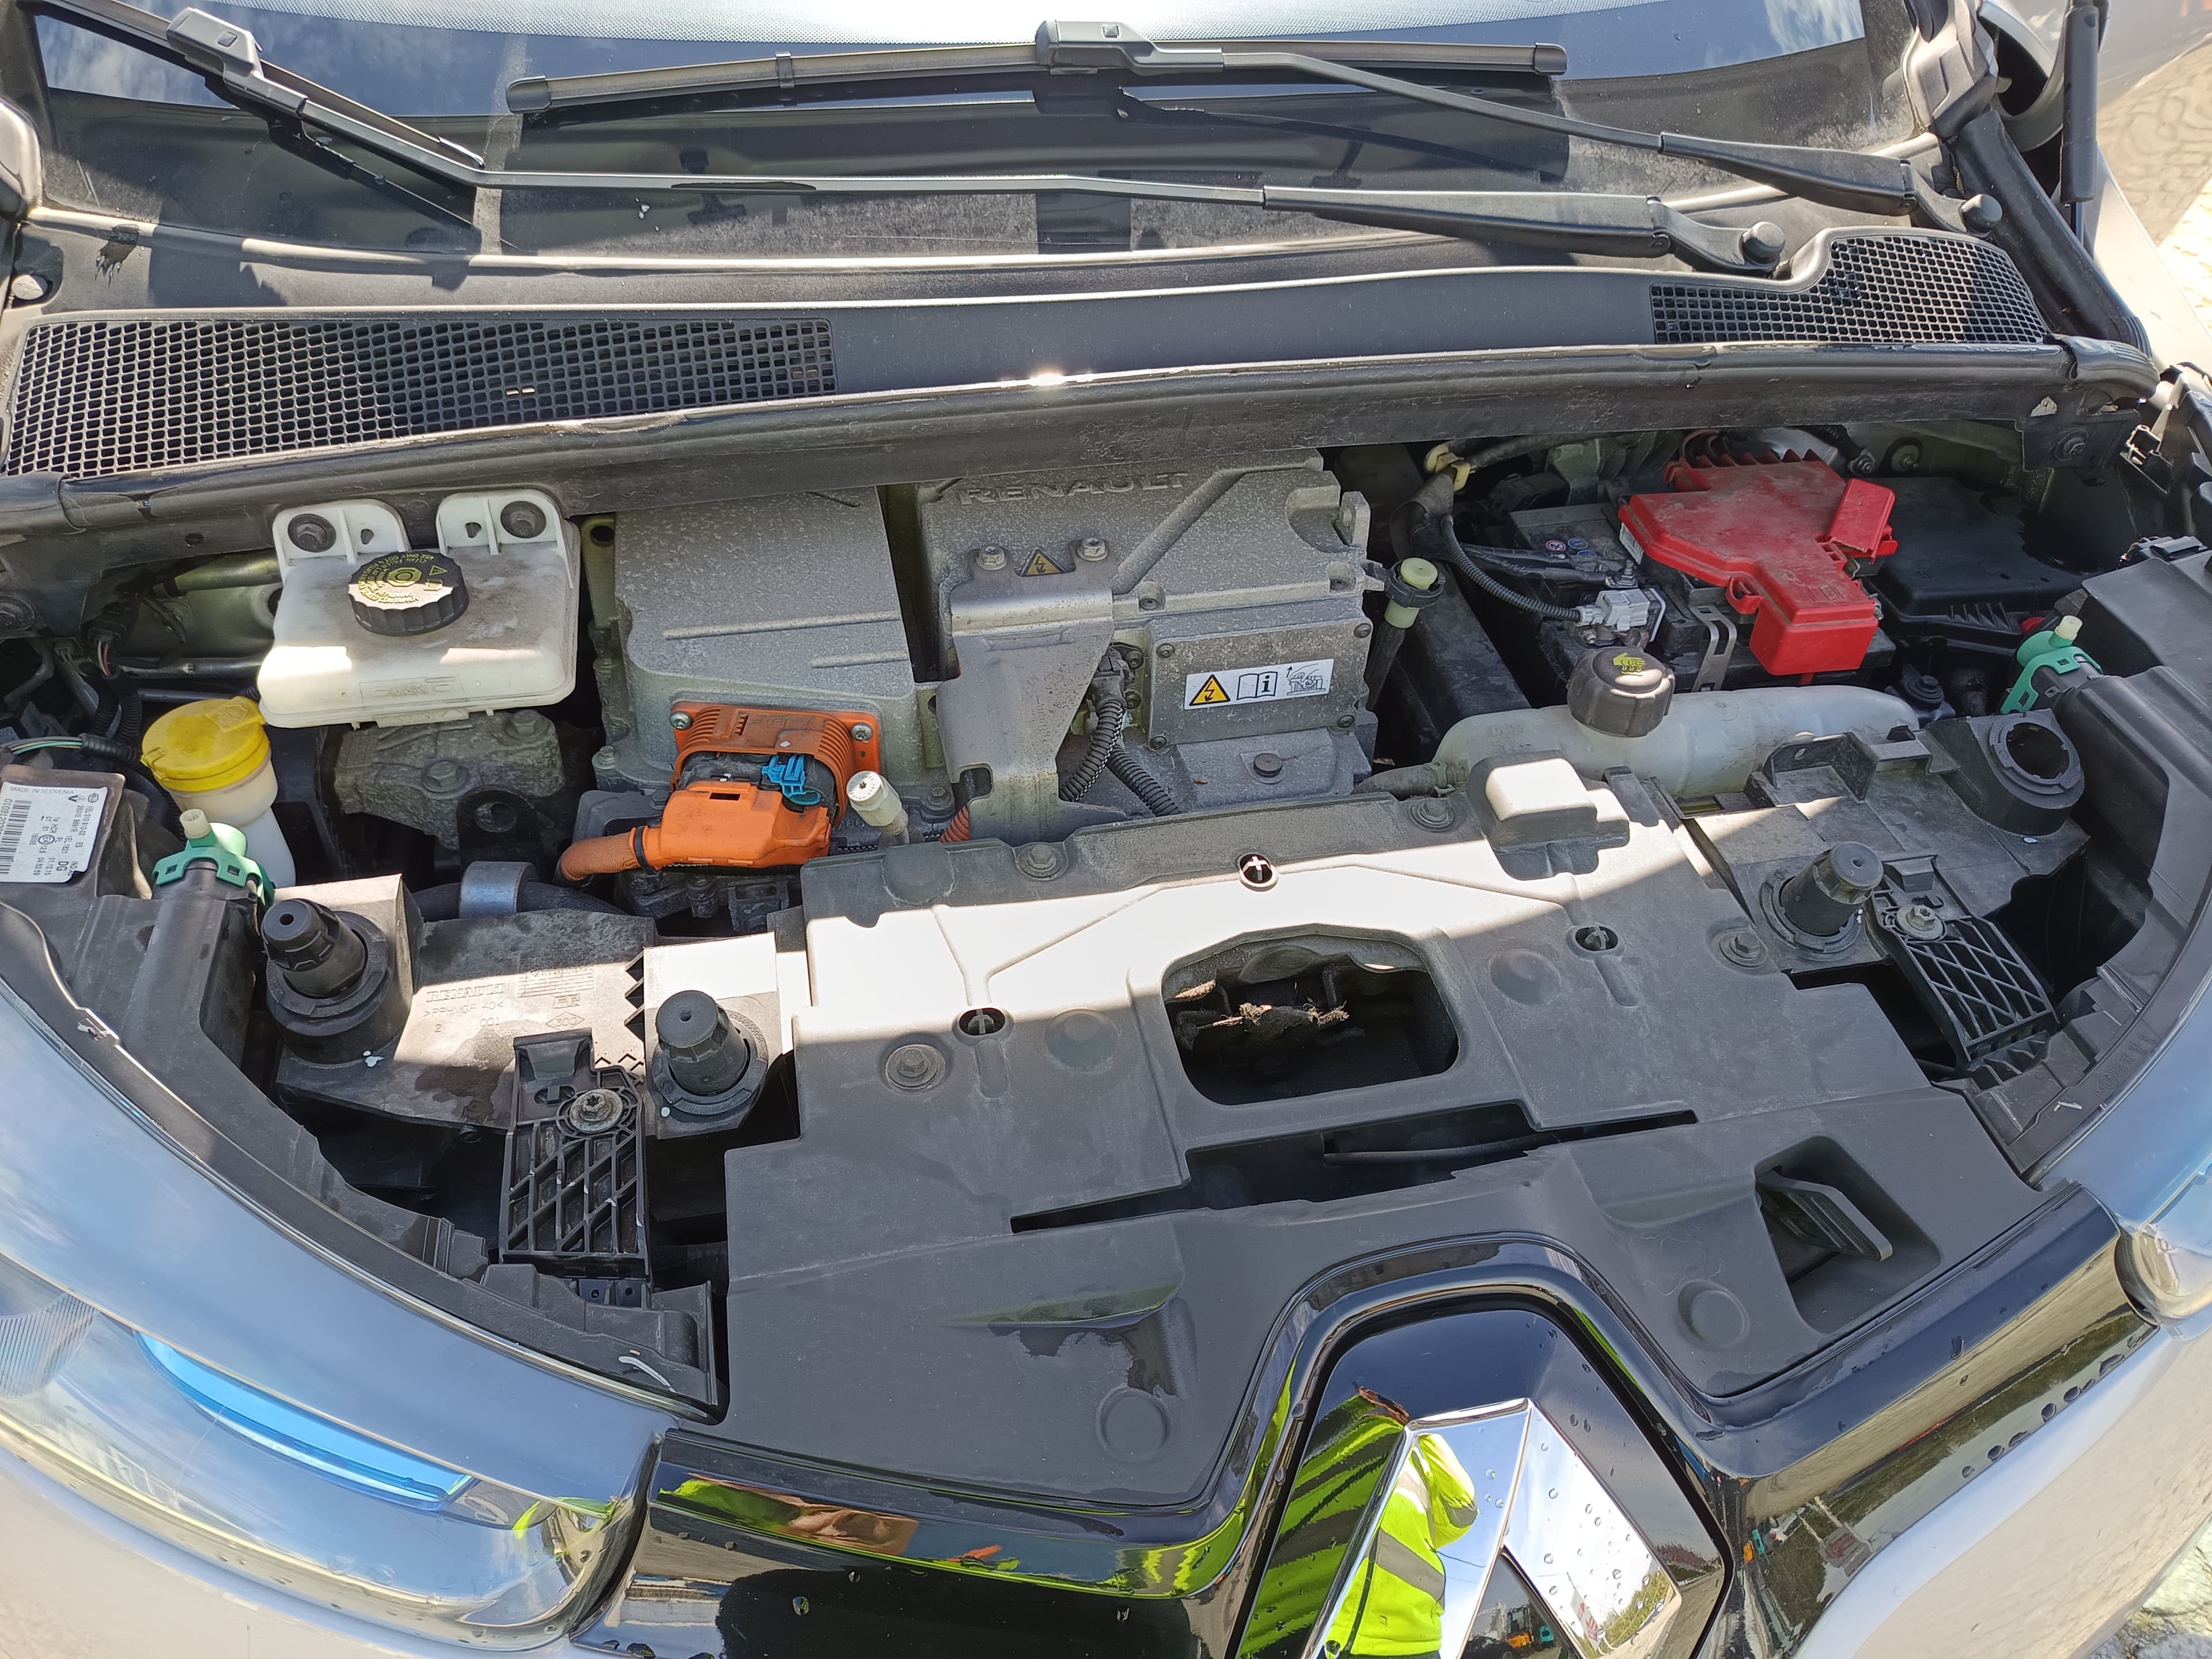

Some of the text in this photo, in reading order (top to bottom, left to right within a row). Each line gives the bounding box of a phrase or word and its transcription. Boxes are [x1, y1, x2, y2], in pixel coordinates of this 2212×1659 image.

[958, 472, 1189, 505] RENAULT
[56, 861, 69, 871] DG
[426, 983, 507, 1002] RENAULT
[434, 1016, 501, 1033] 2 001
[554, 1016, 578, 1028] 300
